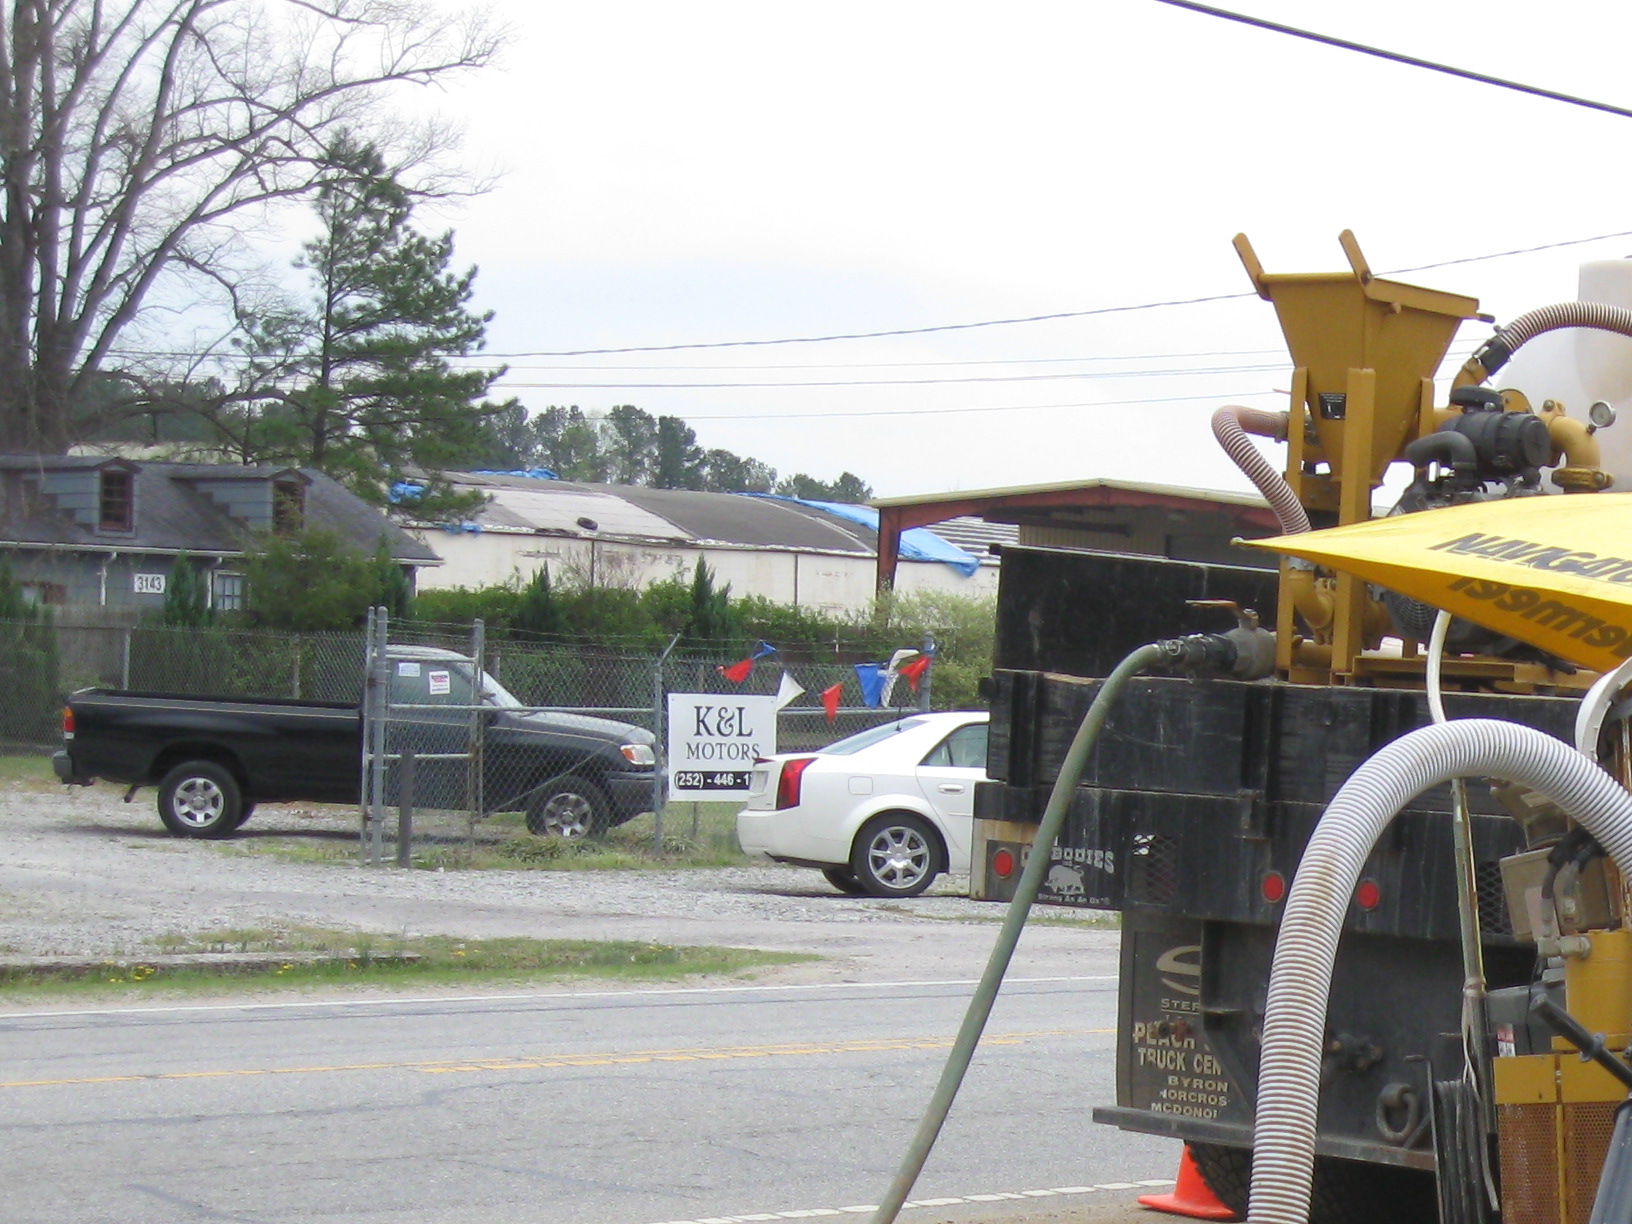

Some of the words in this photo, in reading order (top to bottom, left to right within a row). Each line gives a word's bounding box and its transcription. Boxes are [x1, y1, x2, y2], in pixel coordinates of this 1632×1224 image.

[136, 575, 162, 591] 3143
[693, 705, 754, 738] K&L
[686, 742, 761, 761] MOTORS
[675, 773, 704, 789] (252)
[713, 773, 735, 787] 446
[1051, 846, 1115, 874] BODIES
[1138, 1047, 1187, 1072] TRUCK
[1168, 1075, 1230, 1093] BYRON
